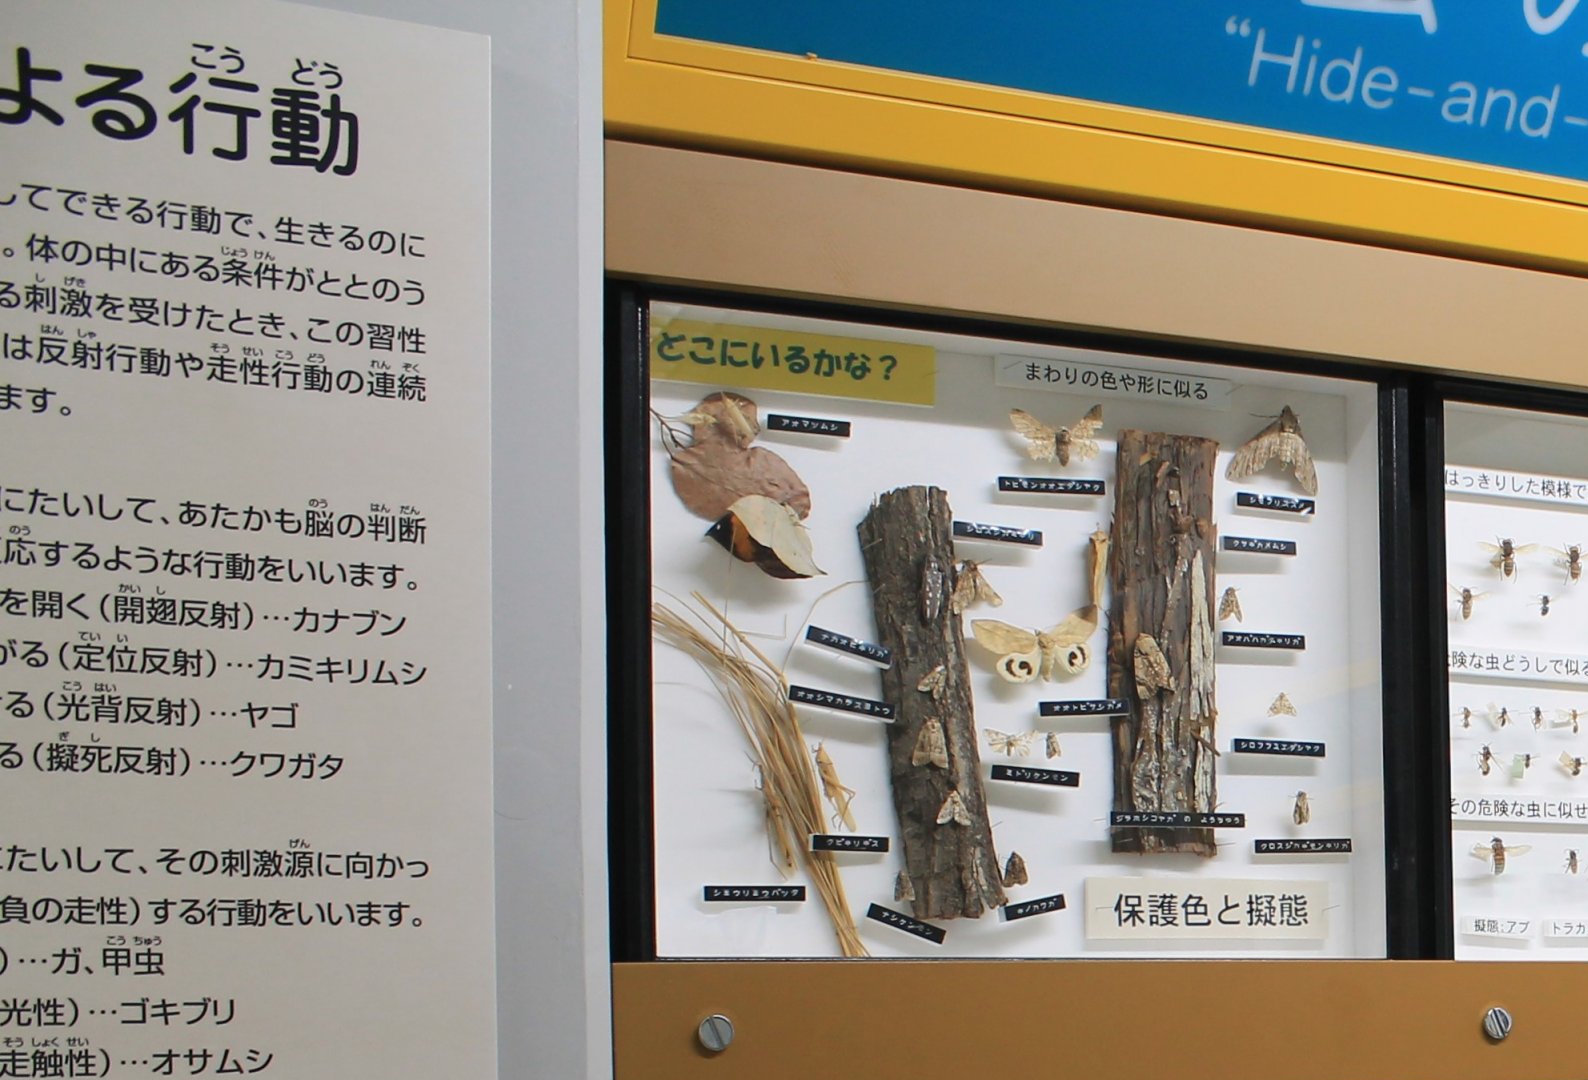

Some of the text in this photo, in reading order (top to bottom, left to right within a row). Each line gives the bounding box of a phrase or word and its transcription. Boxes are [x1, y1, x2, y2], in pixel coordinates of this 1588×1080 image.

[190, 43, 344, 89] こう どう
[0, 47, 358, 176] よる行動
[0, 281, 426, 355] る刺激を受けたとき、この習性
[3, 332, 426, 402] は反射行動や走性行動の連続
[657, 333, 897, 380] どこにいるかな？
[0, 384, 72, 416] ます。
[1026, 363, 1208, 399] まわりの色や形に似る
[0, 488, 427, 545] にたいして、あたかも脳の判断
[0, 537, 419, 591] 応するような行動をいいます。
[0, 692, 300, 729] る（光背反射）…ヤゴ
[0, 844, 430, 880] たいして、その刺激源に向かっ
[1113, 893, 1309, 927] 保護色と擬態
